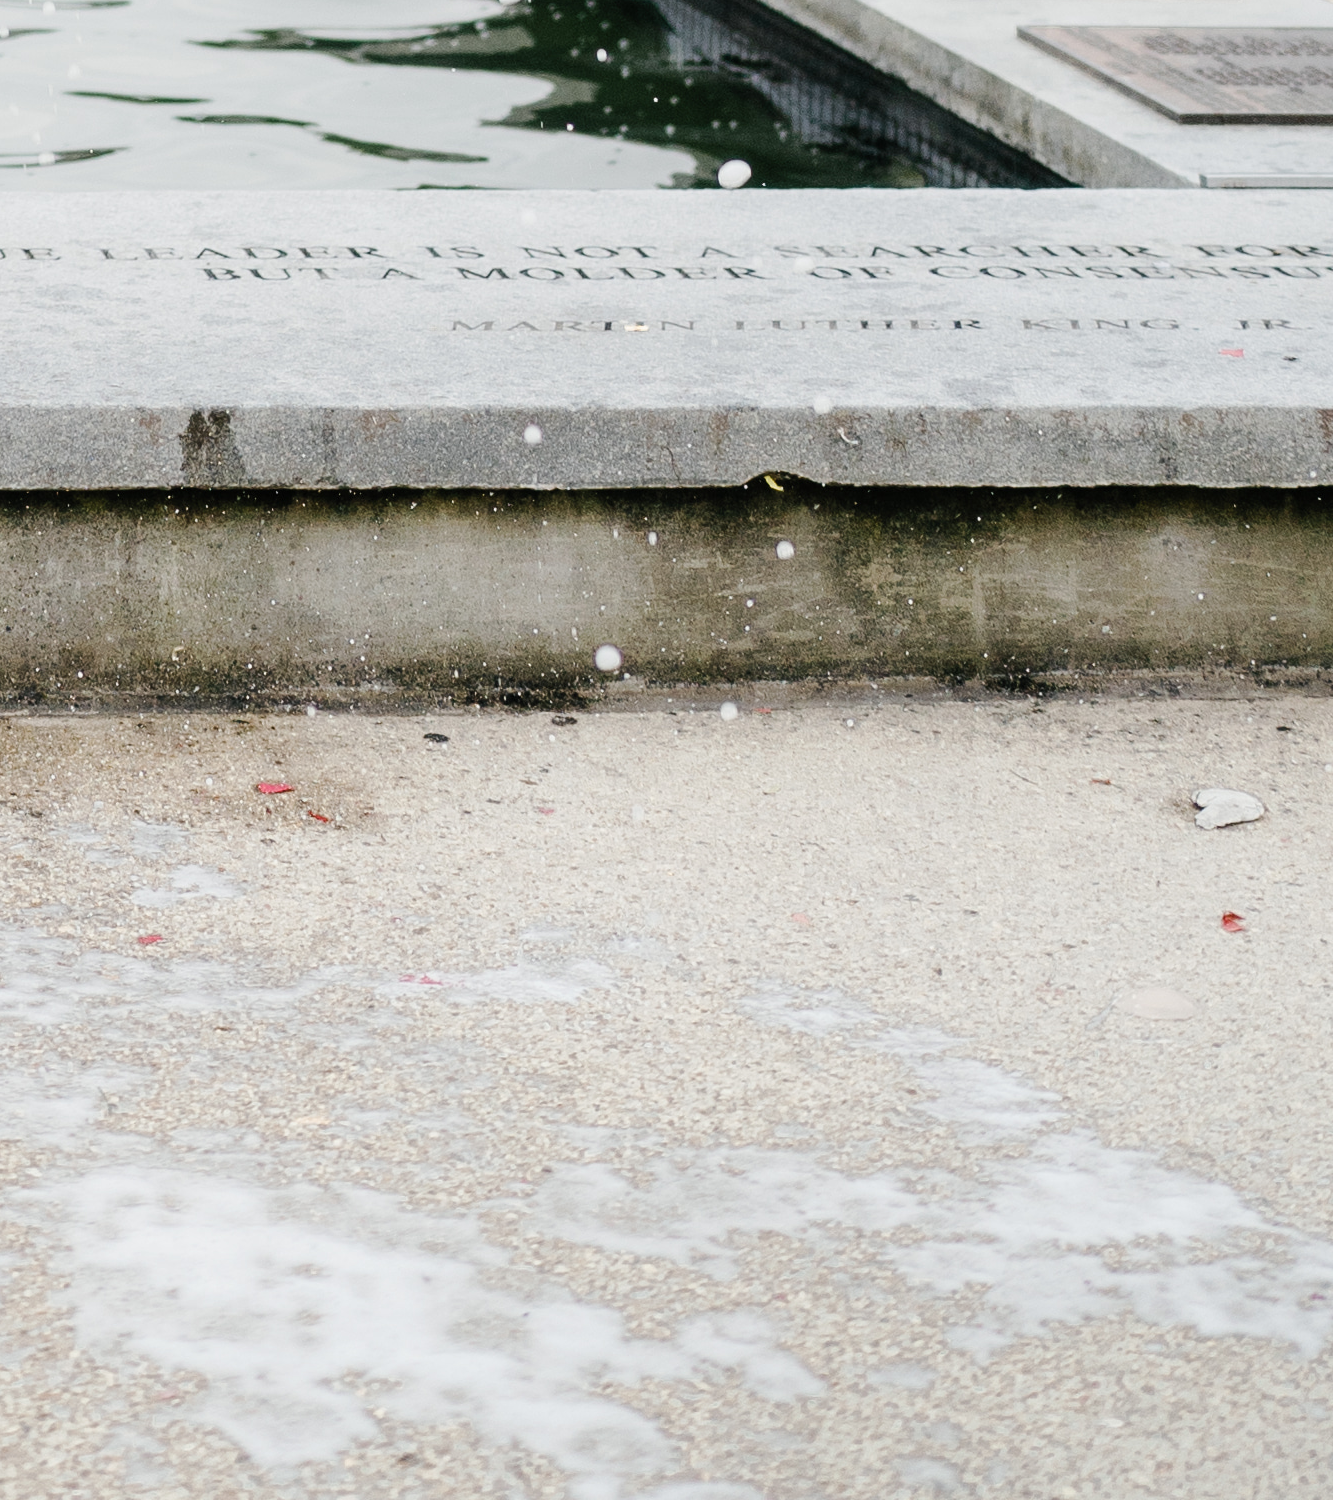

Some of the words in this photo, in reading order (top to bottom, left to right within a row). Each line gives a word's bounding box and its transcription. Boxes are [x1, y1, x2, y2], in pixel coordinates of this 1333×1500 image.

[97, 247, 391, 260] LEADER
[418, 246, 486, 259] IS
[520, 246, 658, 258] NOT
[700, 246, 740, 258] A
[773, 245, 1171, 258] SEARCHER
[1185, 244, 1333, 257] FOR
[197, 268, 338, 280] BUT
[382, 268, 424, 280] A
[449, 267, 776, 280] MOLDER
[808, 266, 893, 279] OF
[733, 319, 985, 330] LUTHER
